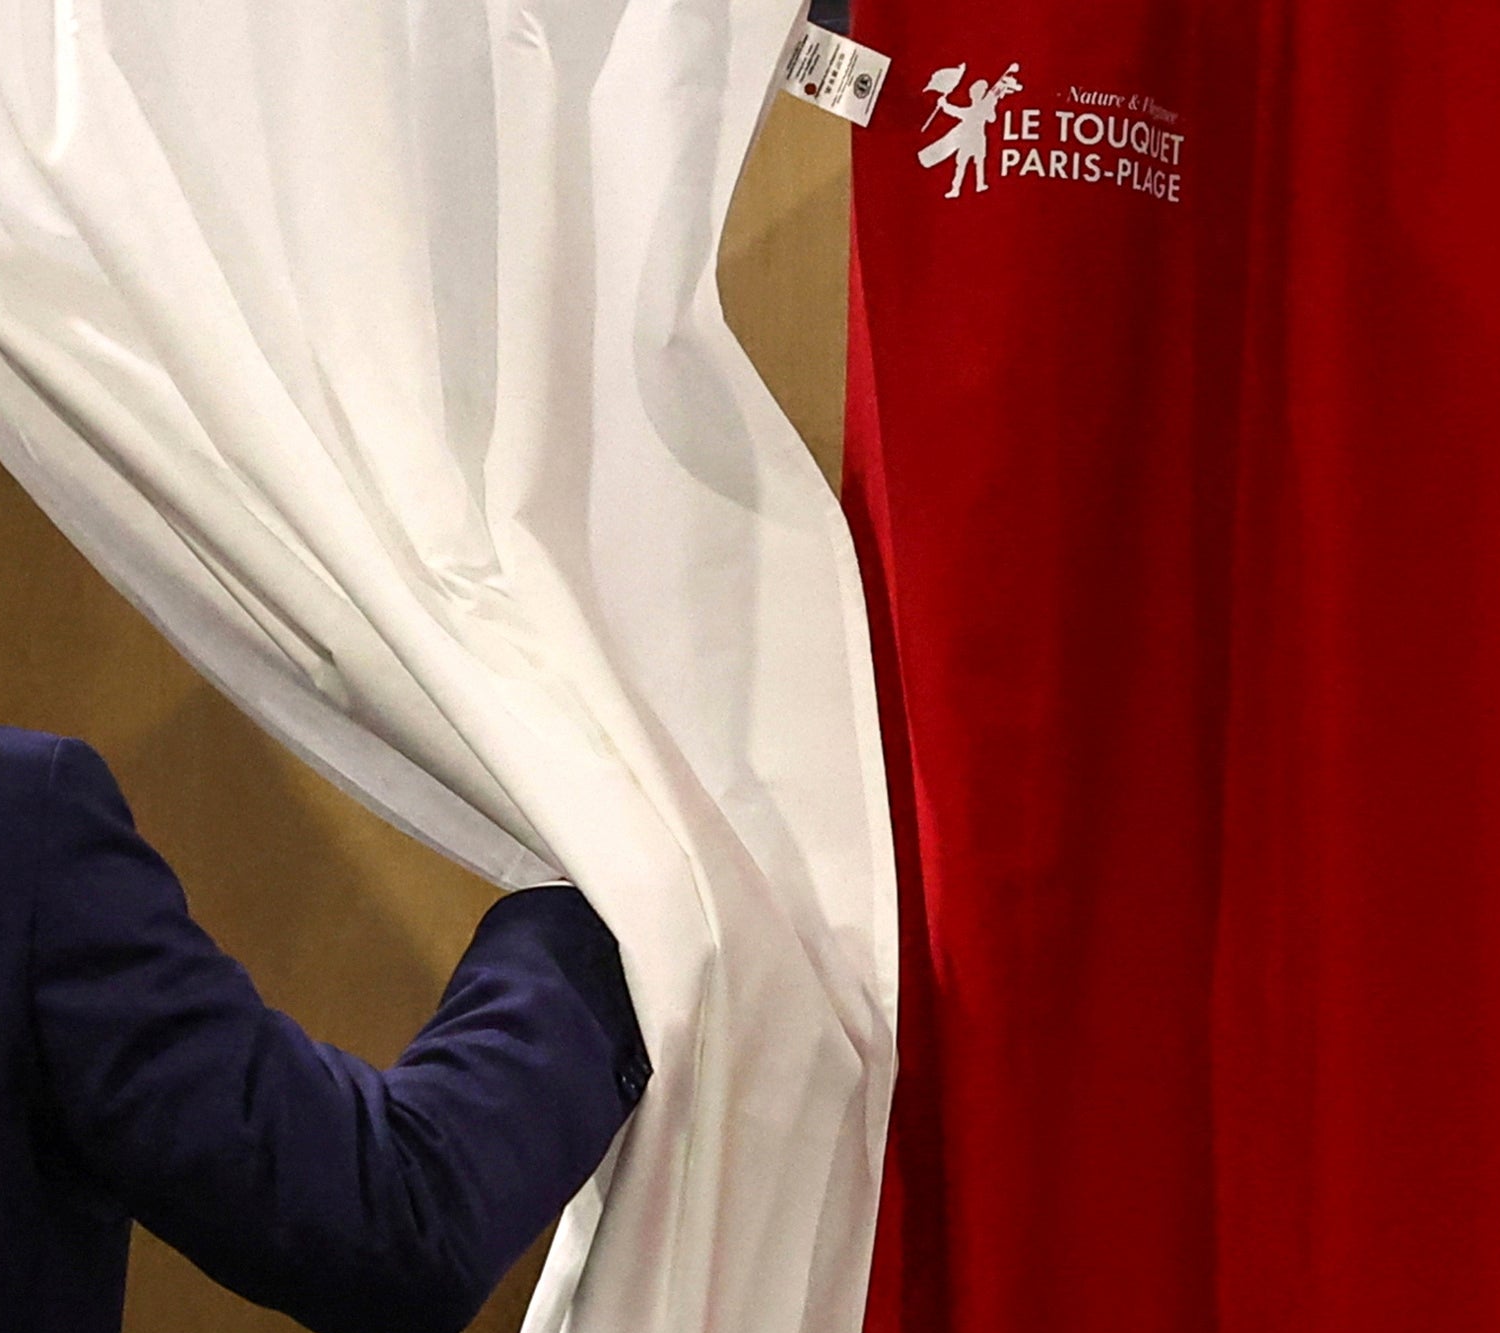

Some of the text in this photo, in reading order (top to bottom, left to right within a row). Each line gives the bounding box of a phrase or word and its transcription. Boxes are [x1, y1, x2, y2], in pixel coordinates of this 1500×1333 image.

[1067, 86, 1125, 108] Nature
[1128, 94, 1140, 111] &
[1003, 109, 1041, 141] LE
[1055, 110, 1185, 165] TOUQUET
[1001, 148, 1181, 202] PARIS-PLAGE
